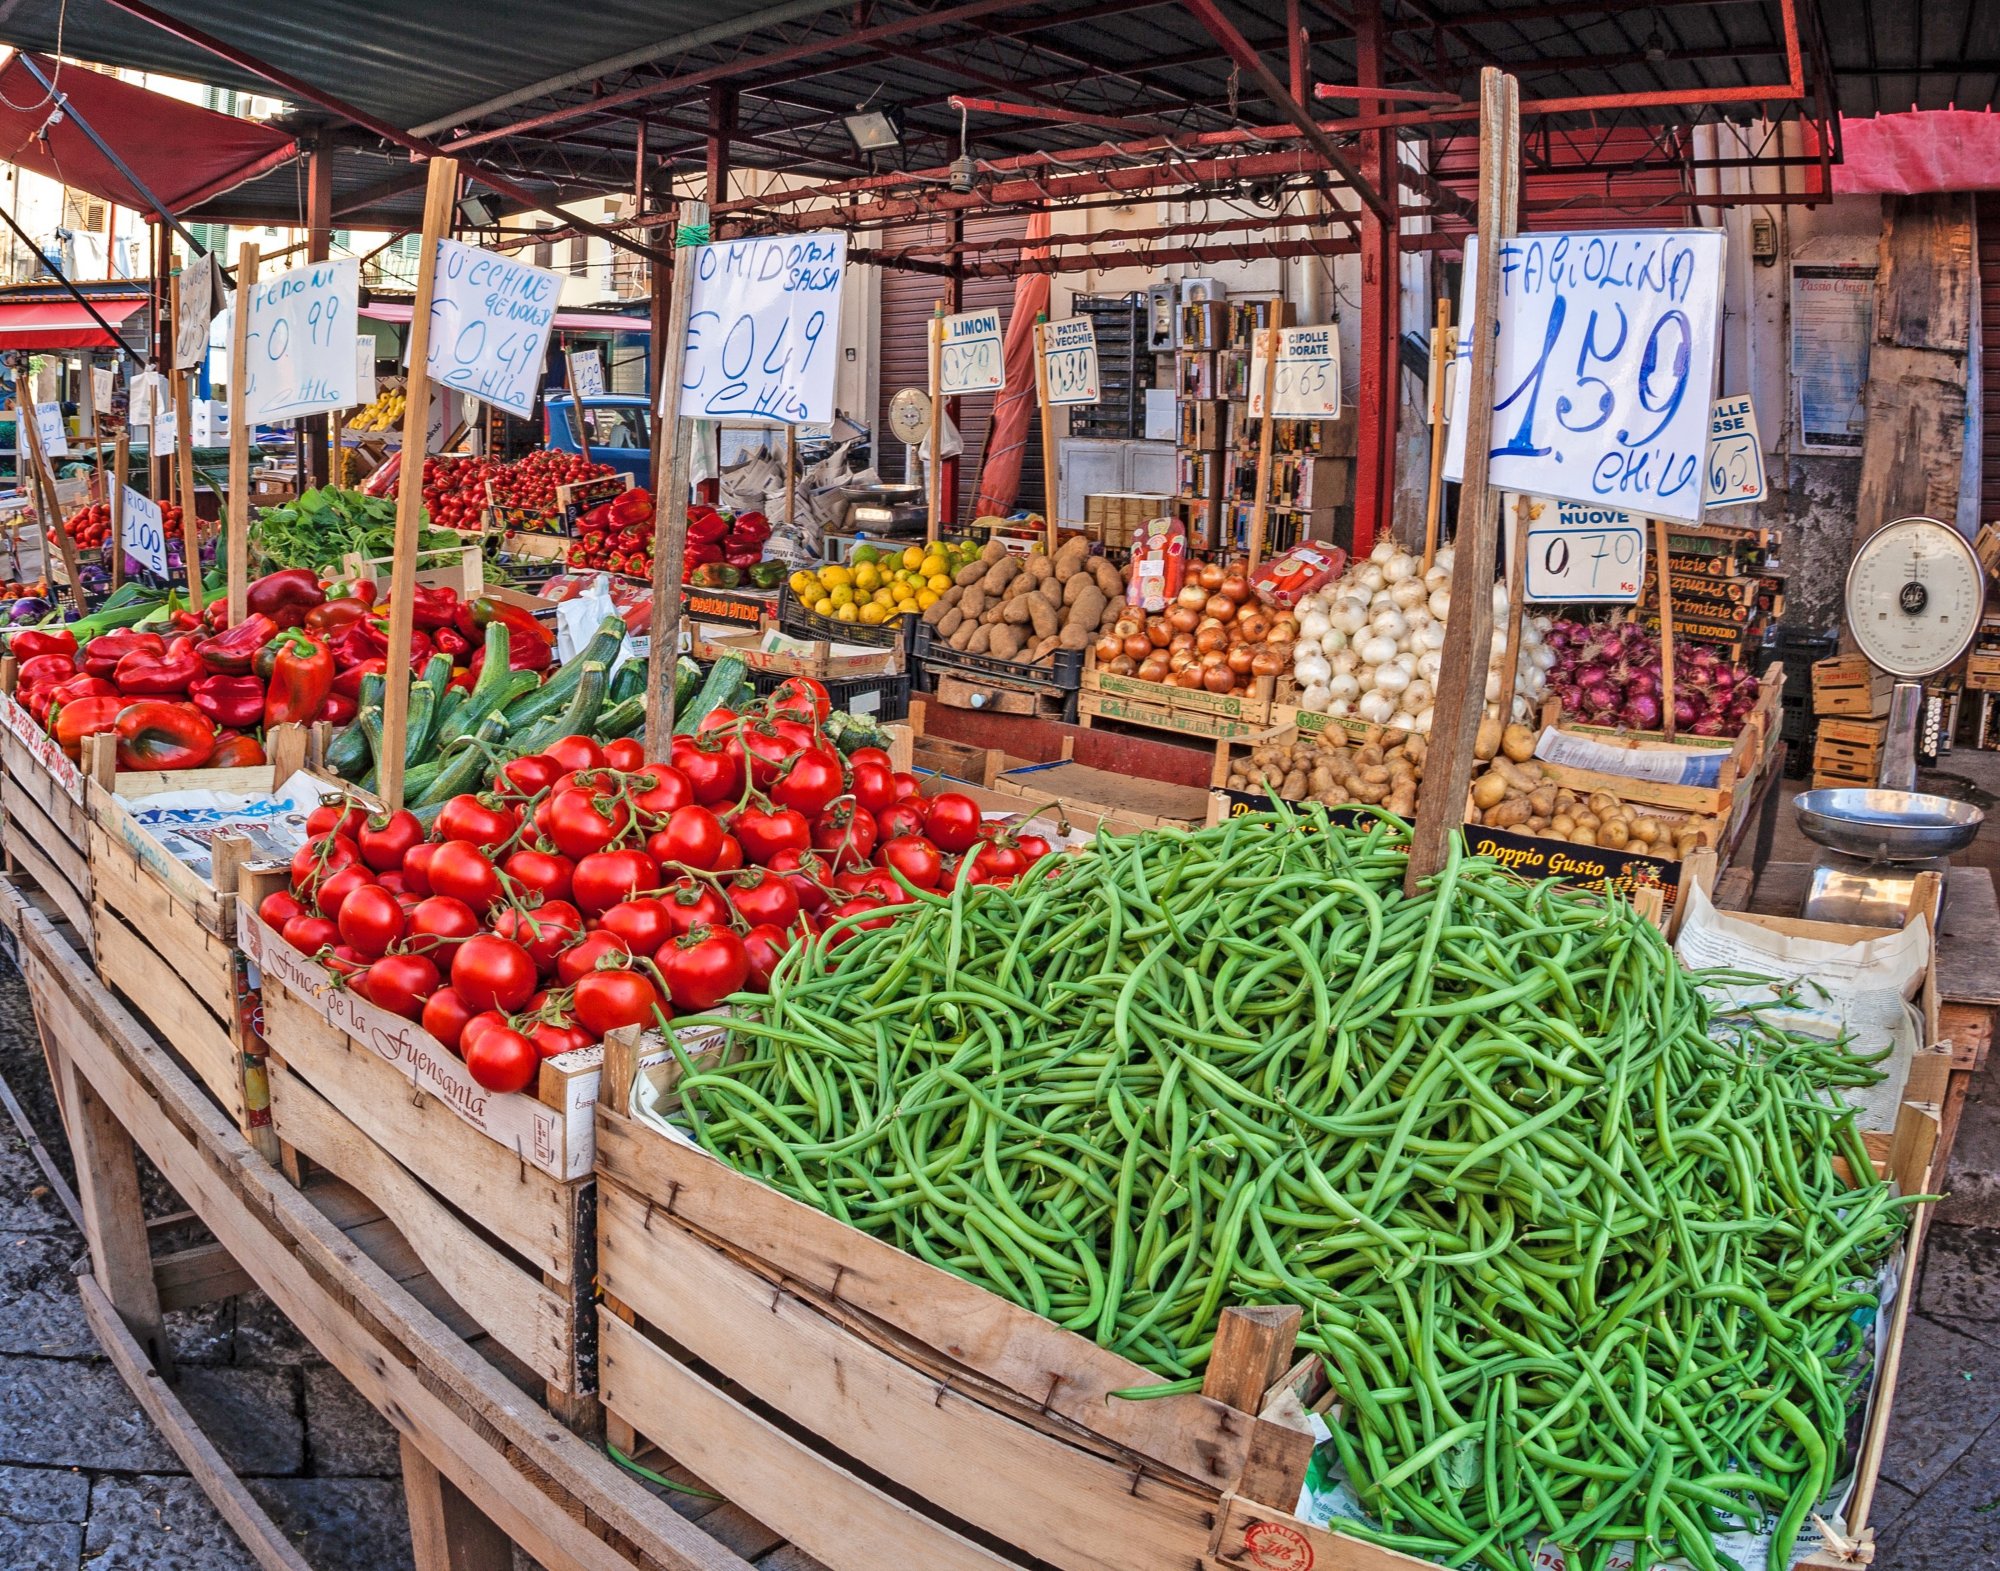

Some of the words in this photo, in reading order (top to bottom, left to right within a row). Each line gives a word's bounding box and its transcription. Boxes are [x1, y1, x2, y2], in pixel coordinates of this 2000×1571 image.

[784, 267, 840, 292] SALSA
[1800, 279, 1831, 292] Passio
[953, 316, 997, 337] LIMONI
[1057, 322, 1089, 336] PATATE
[1055, 333, 1094, 347] VECCHIE
[1288, 331, 1329, 344] CIPOLLE
[1289, 345, 1329, 356] DORATE
[1713, 402, 1751, 419] LLE
[1559, 511, 1630, 525] NUOVE
[1646, 553, 1707, 570] Prmizie
[1477, 840, 1544, 868] Doppio
[1548, 853, 1605, 876] Gusto
[349, 1000, 366, 1033] la
[370, 1027, 488, 1117] Fuensanta
